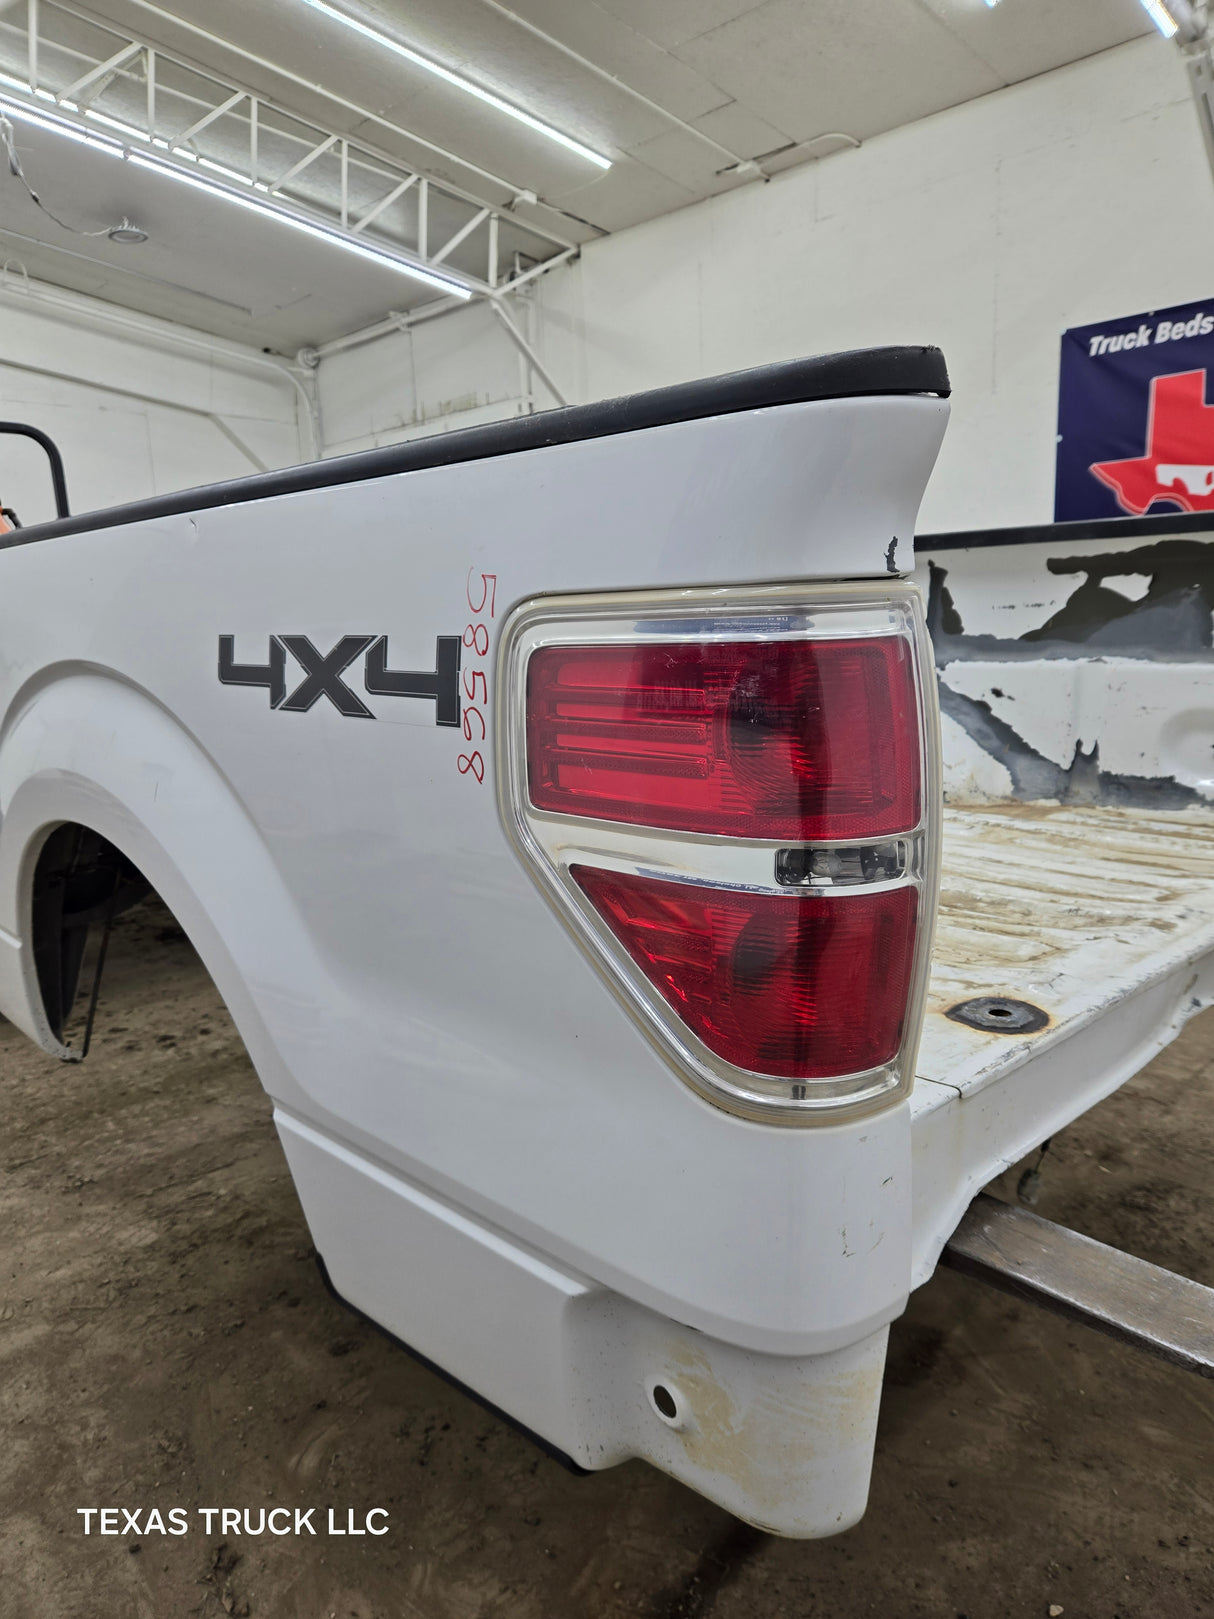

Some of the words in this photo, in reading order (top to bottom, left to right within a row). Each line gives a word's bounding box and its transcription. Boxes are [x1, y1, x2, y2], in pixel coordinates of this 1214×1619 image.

[1089, 324, 1152, 357] Truck
[1154, 312, 1214, 344] Beds
[217, 634, 462, 728] 4X4
[457, 566, 497, 785] 58568
